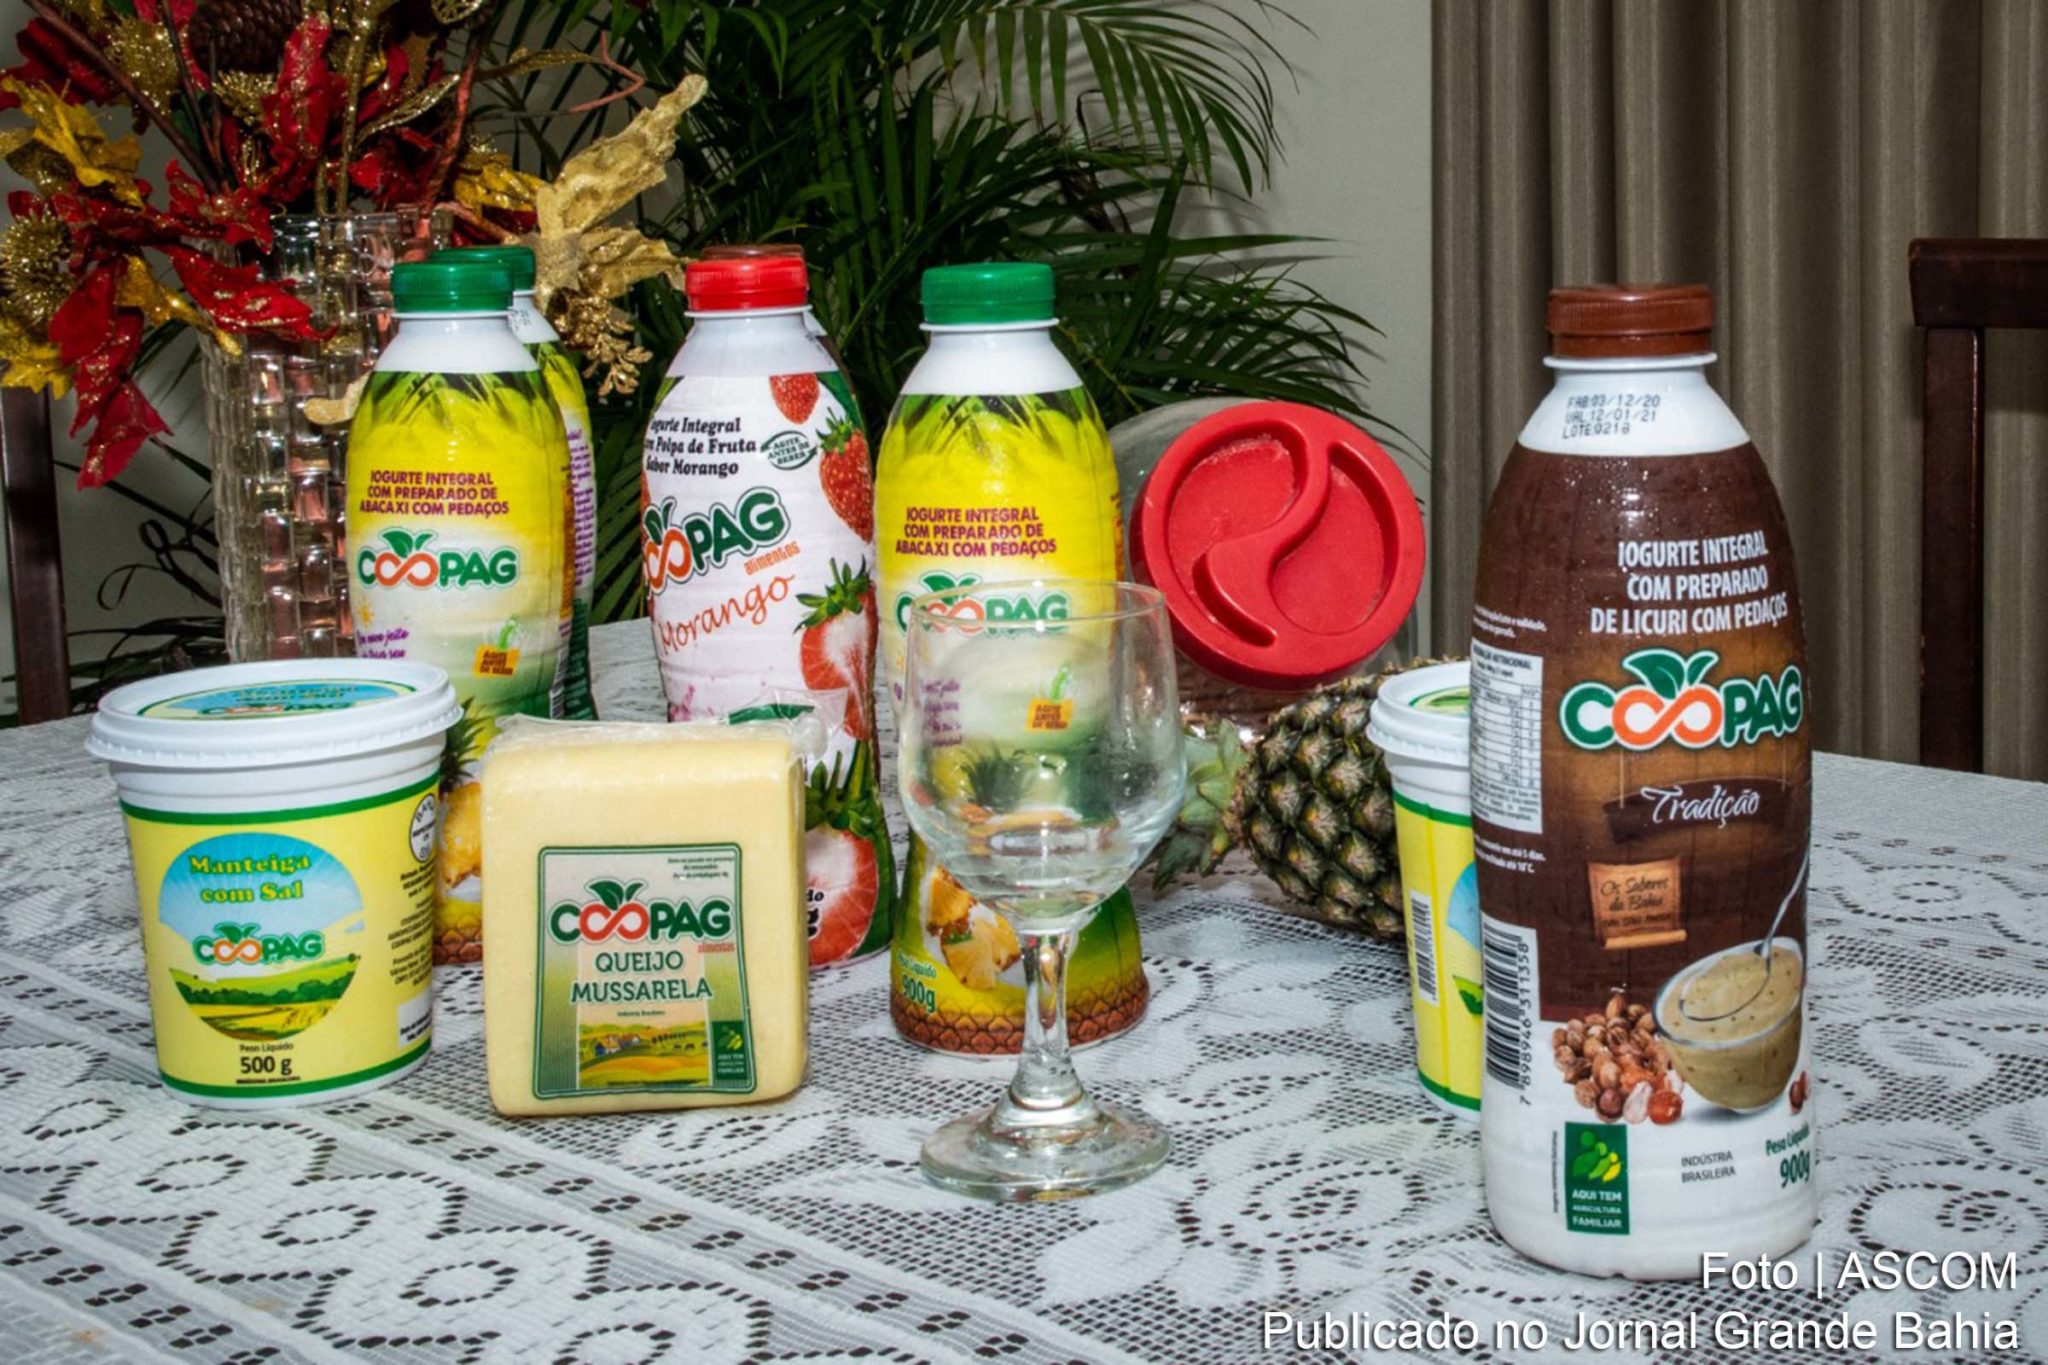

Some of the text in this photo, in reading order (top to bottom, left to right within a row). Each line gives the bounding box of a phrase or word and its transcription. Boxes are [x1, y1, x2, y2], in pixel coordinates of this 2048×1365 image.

[681, 417, 741, 436] Integral
[656, 436, 684, 457] Polpa
[688, 438, 705, 453] de
[708, 438, 757, 454] Fruta
[371, 470, 494, 486] IOGURTE INTEGRAL
[672, 458, 739, 478] Morango
[368, 486, 497, 500] COM PREPARADO DE
[360, 500, 509, 518] ABACAXI COM PEDAÇOS
[906, 507, 1039, 523] IOGURTE INTEGRAL
[904, 523, 1043, 539] COM PREPARADO DE
[896, 538, 1057, 560] ABACAXI COM PEDAÇOS
[1618, 530, 1769, 567] IOGURTE INTEGRAL
[356, 548, 518, 588] COOPAG
[1627, 564, 1769, 601] COM PREPARADO
[659, 574, 796, 655] Morango
[1591, 591, 1788, 635] DE LICURI COM PEDAÇOS
[1561, 667, 1802, 749] COOPAG
[1641, 785, 1760, 830] Tradição
[189, 854, 312, 876] Manteiga
[201, 880, 304, 903] com Sal
[550, 900, 732, 941] COOPAG
[193, 931, 324, 965] COOPAG
[595, 951, 684, 972] QUEIJO
[571, 979, 713, 1003] MUSSARELA
[902, 973, 936, 1014] 900g
[240, 1056, 292, 1076] 500 g
[1519, 1096, 1532, 1107] 7
[1681, 1150, 1734, 1167] INDÚSTRIA
[1780, 1149, 1811, 1189] 900g
[1681, 1165, 1736, 1183] BRASILEIRA
[1572, 1189, 1623, 1202] AQUI TEM
[1572, 1216, 1623, 1229] FAMILIAR
